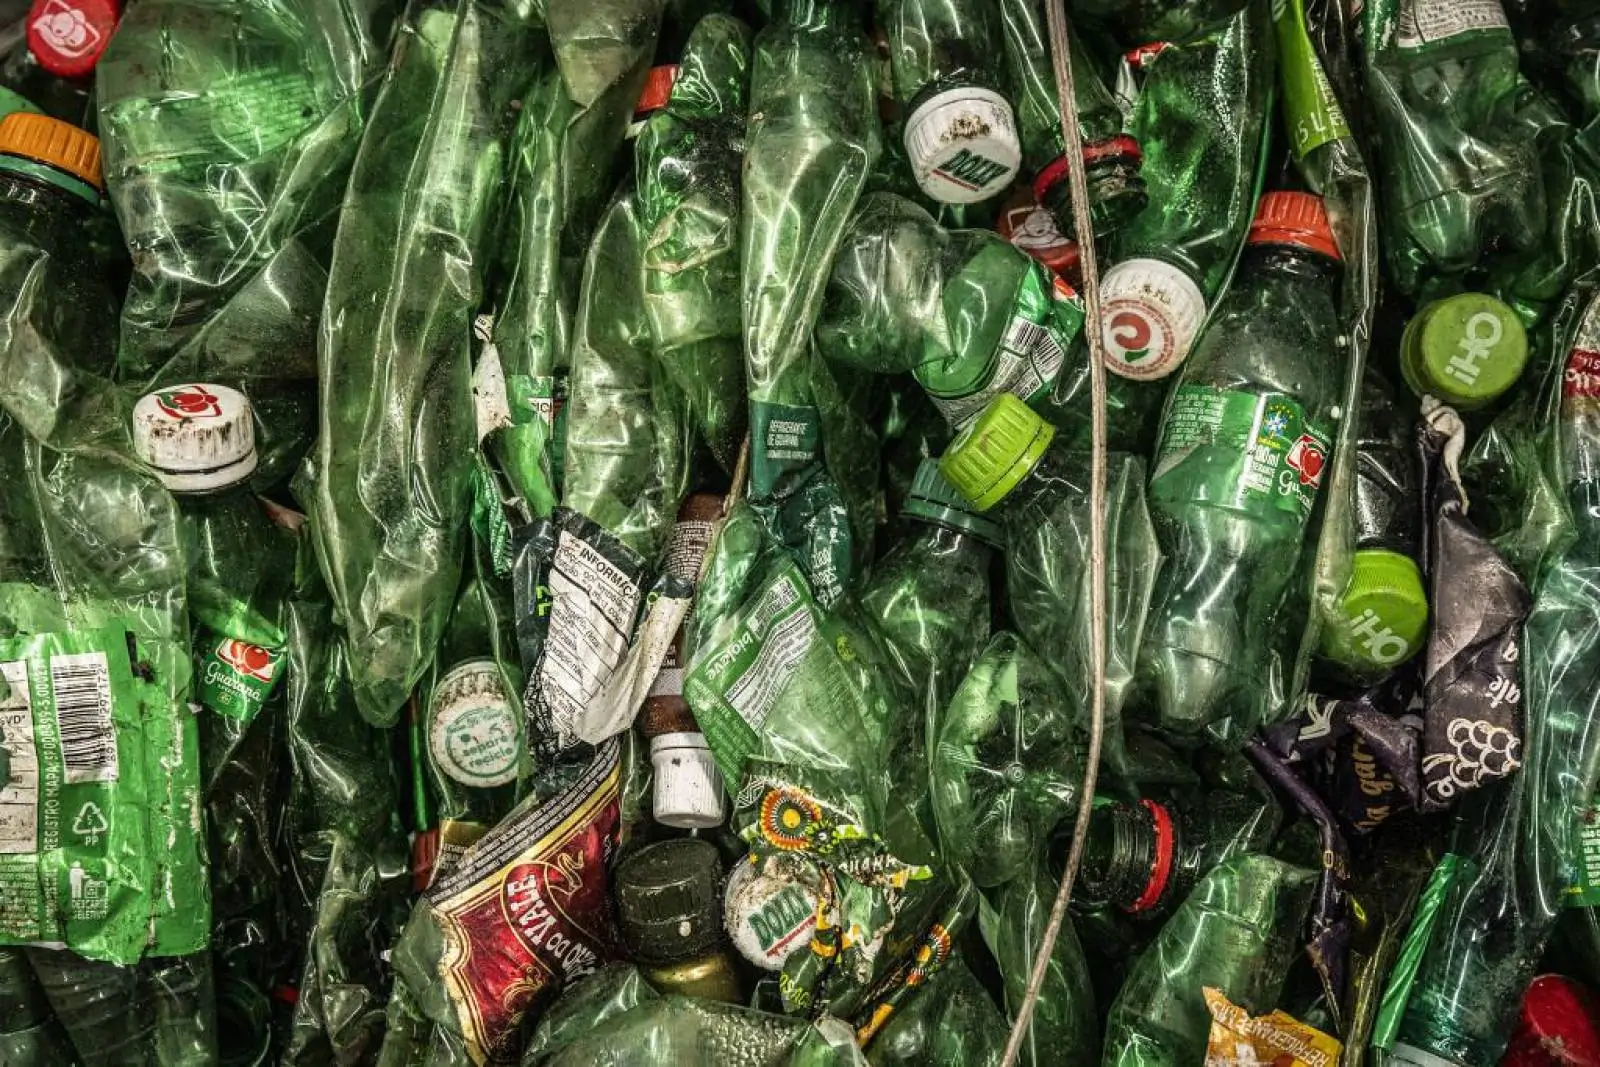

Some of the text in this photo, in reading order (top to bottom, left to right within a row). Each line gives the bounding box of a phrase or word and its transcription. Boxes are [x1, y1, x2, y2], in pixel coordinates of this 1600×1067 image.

[936, 147, 1012, 188] DOLLY
[44, 799, 60, 851] REGISTRO
[85, 835, 99, 847] PP
[506, 874, 558, 946] VALE
[747, 880, 813, 951] DOLLY
